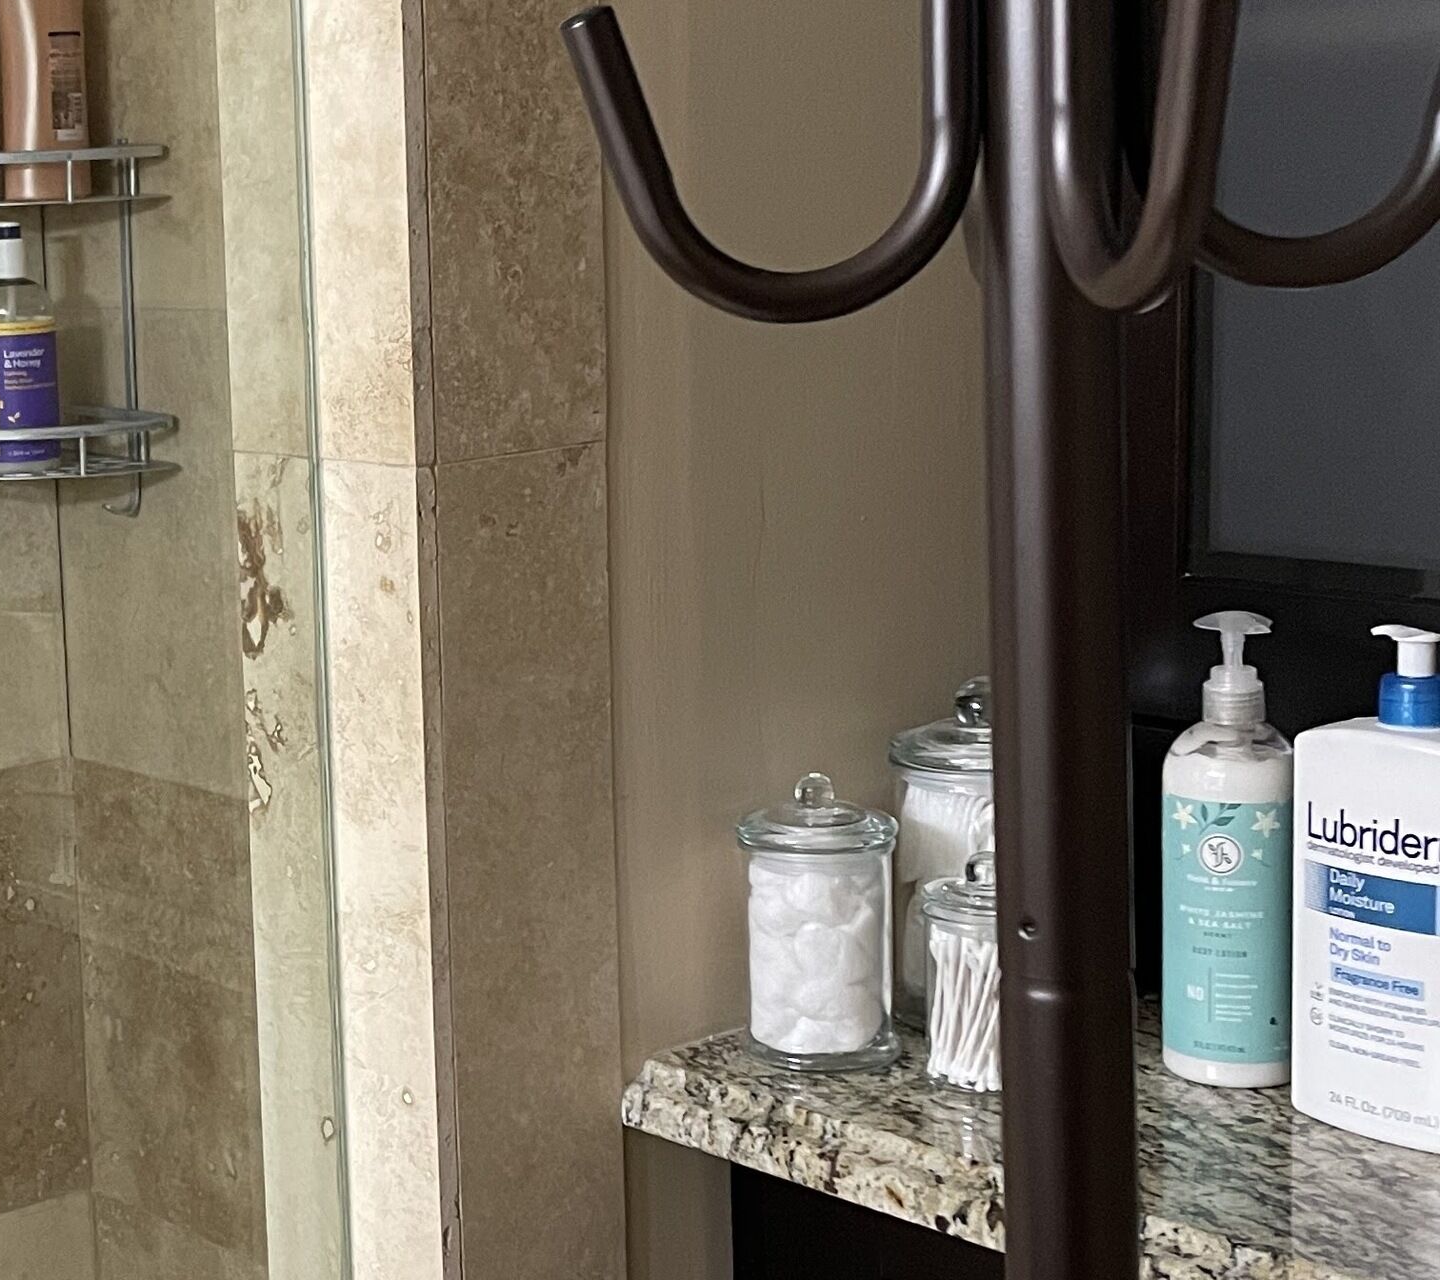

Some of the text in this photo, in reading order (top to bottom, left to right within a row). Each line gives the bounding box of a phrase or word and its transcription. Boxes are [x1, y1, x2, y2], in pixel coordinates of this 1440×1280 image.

[3, 348, 45, 359] Lavender
[3, 359, 41, 369] & Honey
[1307, 800, 1440, 861] Lubrider
[1377, 856, 1439, 875] developed
[1328, 868, 1366, 893] Daily
[1328, 886, 1396, 914] Moisture
[1329, 926, 1392, 952] Normal to
[1329, 942, 1380, 966] Dry Skin
[1187, 984, 1205, 1001] NO
[1334, 967, 1420, 996] Fragrance Free
[1329, 1090, 1343, 1105] 24
